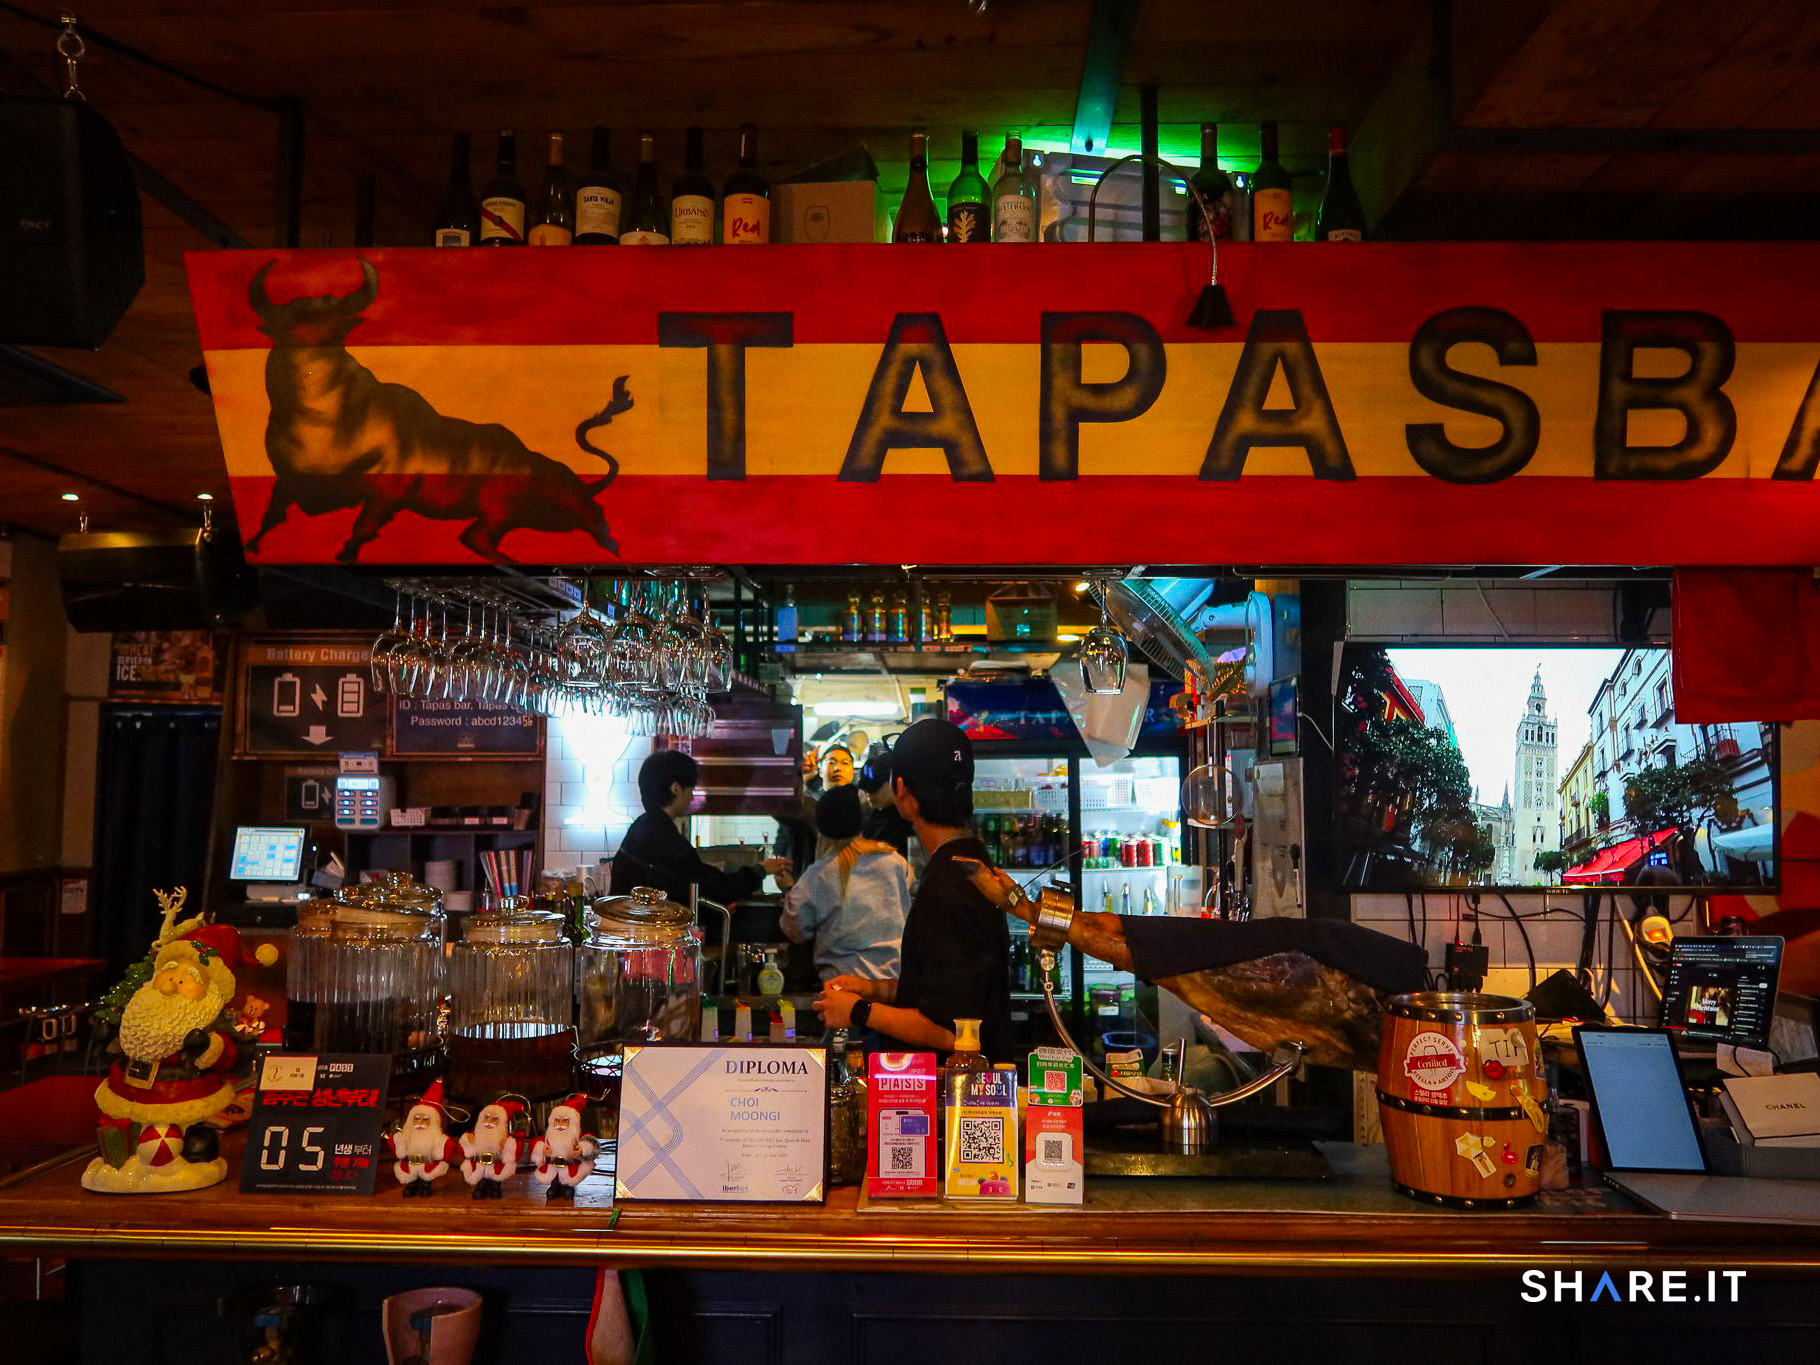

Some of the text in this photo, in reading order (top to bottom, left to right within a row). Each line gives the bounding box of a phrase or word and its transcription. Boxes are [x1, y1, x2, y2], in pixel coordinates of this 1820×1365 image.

[674, 207, 710, 218] URBANO
[1263, 211, 1289, 231] Red
[732, 217, 760, 239] Red
[266, 648, 317, 662] Battery
[421, 700, 451, 712] Tapas
[411, 715, 462, 727] Password
[1409, 1035, 1453, 1056] PERFECT SERVE
[725, 1060, 809, 1075] DIPLOMA
[1417, 1058, 1448, 1069] Certified
[880, 1078, 926, 1091] PASS
[975, 1072, 1003, 1084] SEOUL
[1413, 1070, 1432, 1086] STELLA
[971, 1083, 1008, 1097] MY SOUL
[730, 1097, 759, 1108] CHOI
[1765, 1103, 1806, 1111] CHANEL
[730, 1111, 780, 1121] MOONGI
[260, 1126, 325, 1171] 05
